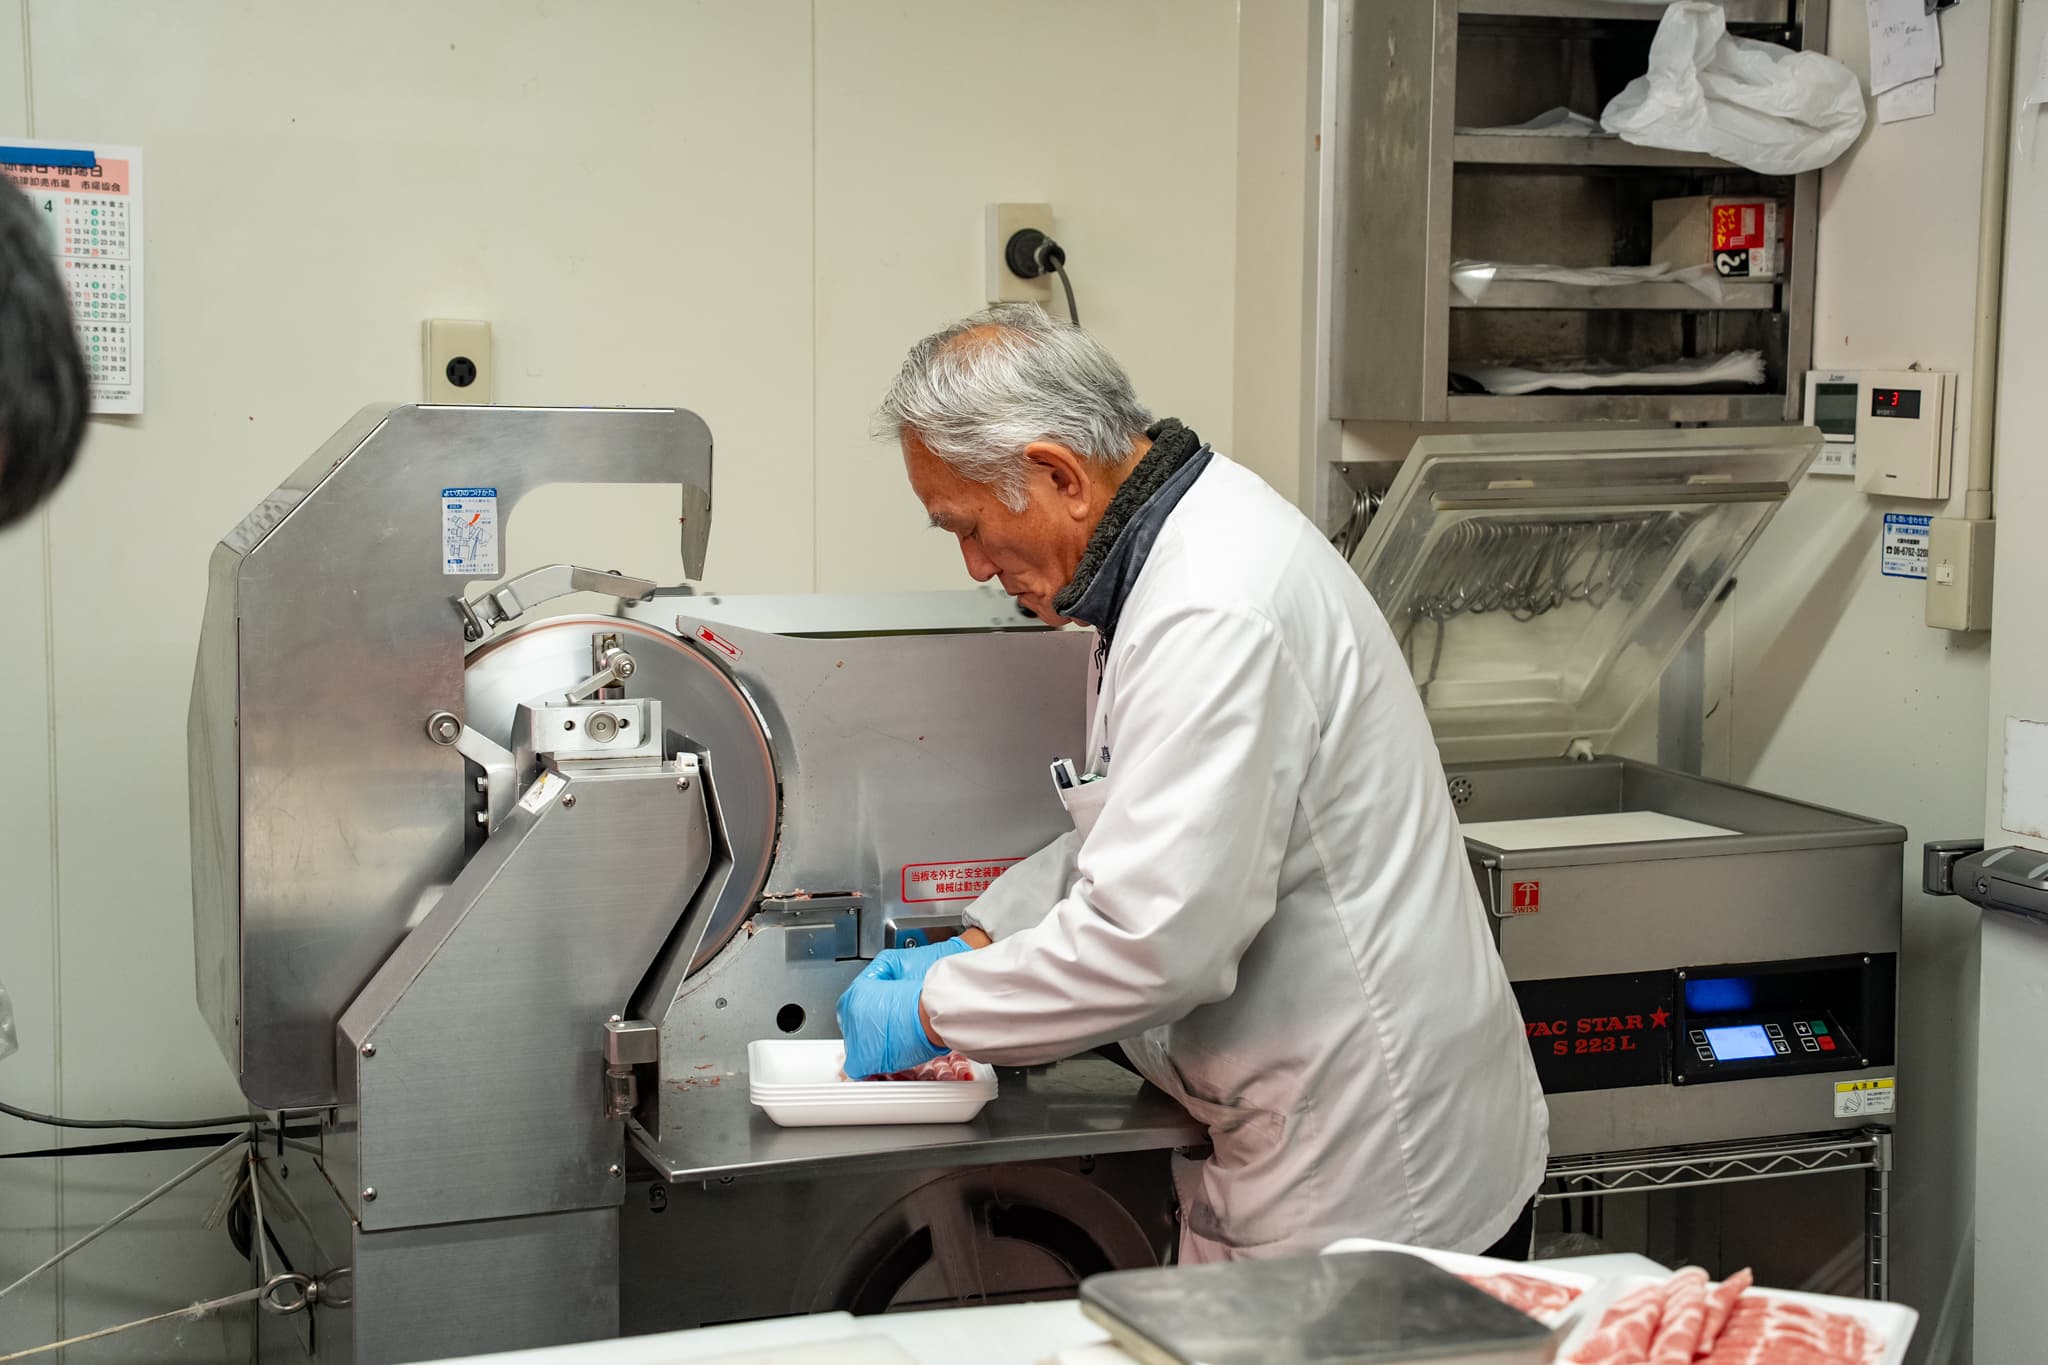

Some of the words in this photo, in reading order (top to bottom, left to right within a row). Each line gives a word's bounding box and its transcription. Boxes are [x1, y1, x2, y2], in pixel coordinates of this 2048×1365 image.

[44, 200, 53, 213] 4
[1525, 1021, 1568, 1036] VAC
[1577, 1014, 1644, 1034] STAR
[1554, 1040, 1568, 1056] S
[1574, 1037, 1616, 1054] 223
